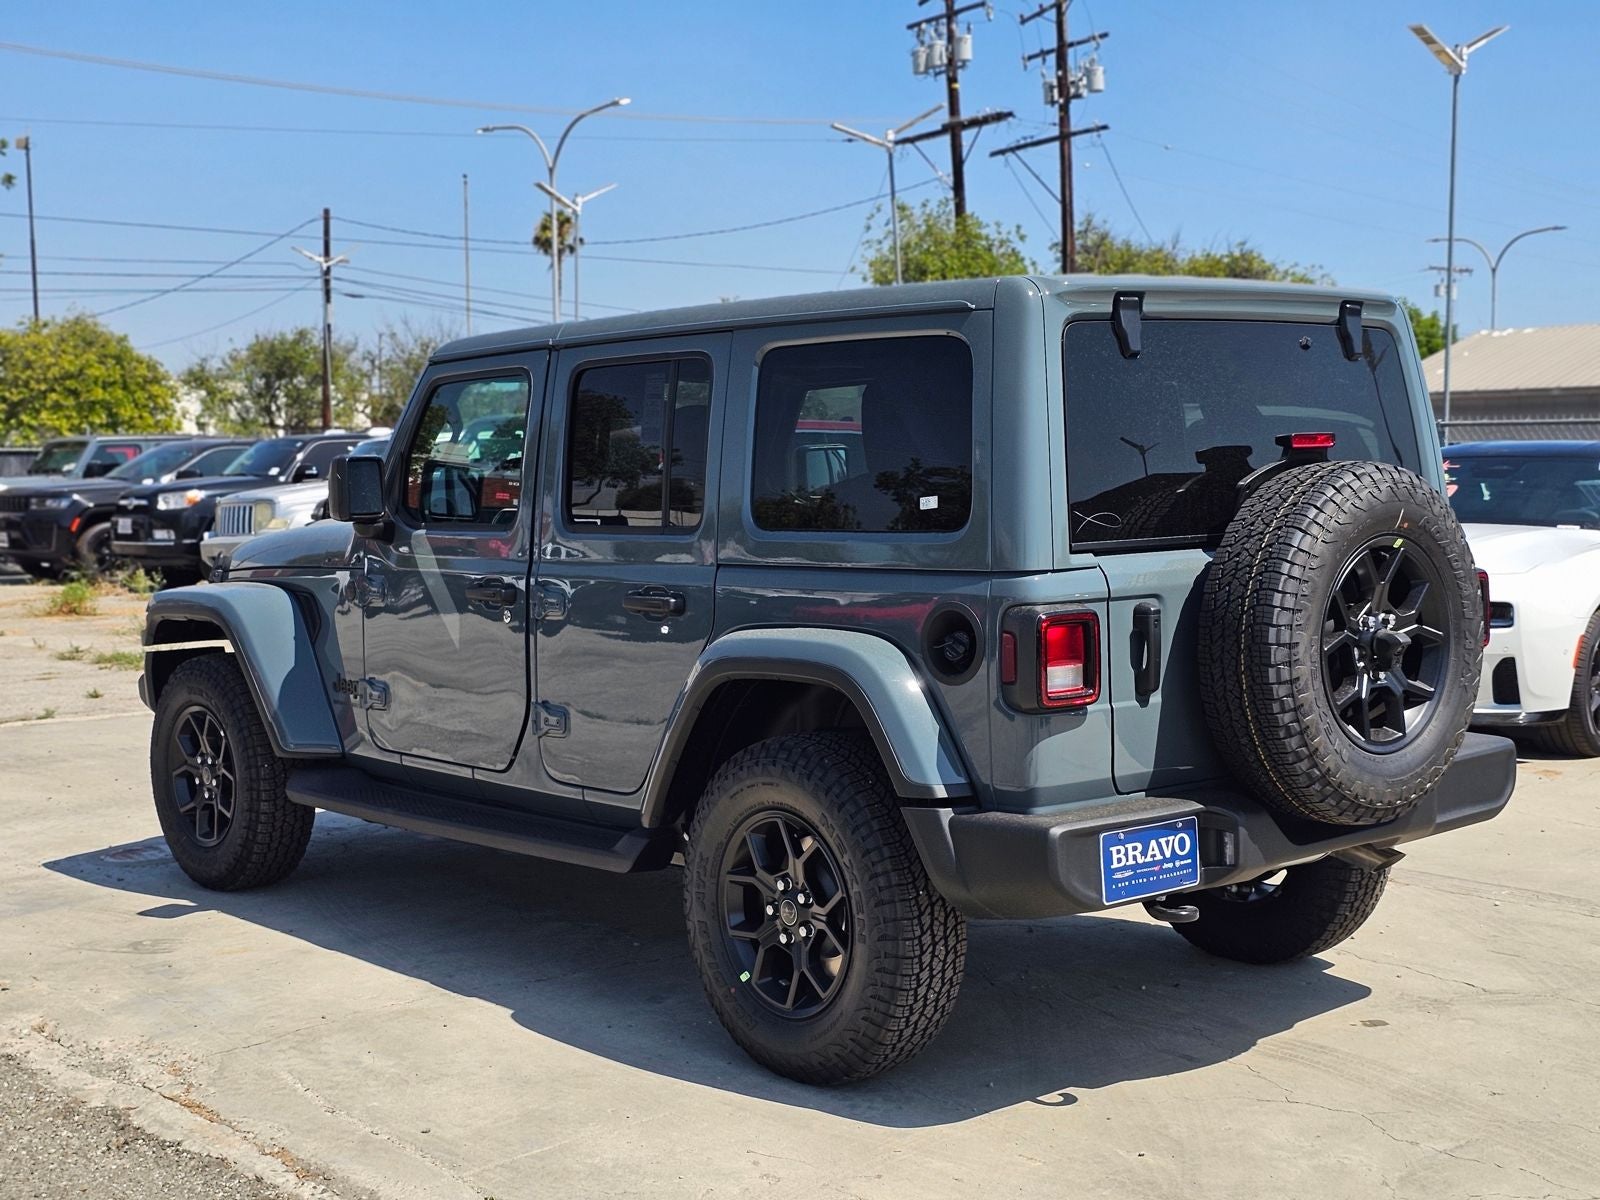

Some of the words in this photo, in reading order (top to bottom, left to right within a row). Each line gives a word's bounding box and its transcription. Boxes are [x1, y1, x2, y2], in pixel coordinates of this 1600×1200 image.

[332, 672, 359, 699] Jeep
[1310, 635, 1349, 763] NEXEN
[818, 811, 866, 945] NEXEN
[1109, 833, 1191, 869] BRAVO
